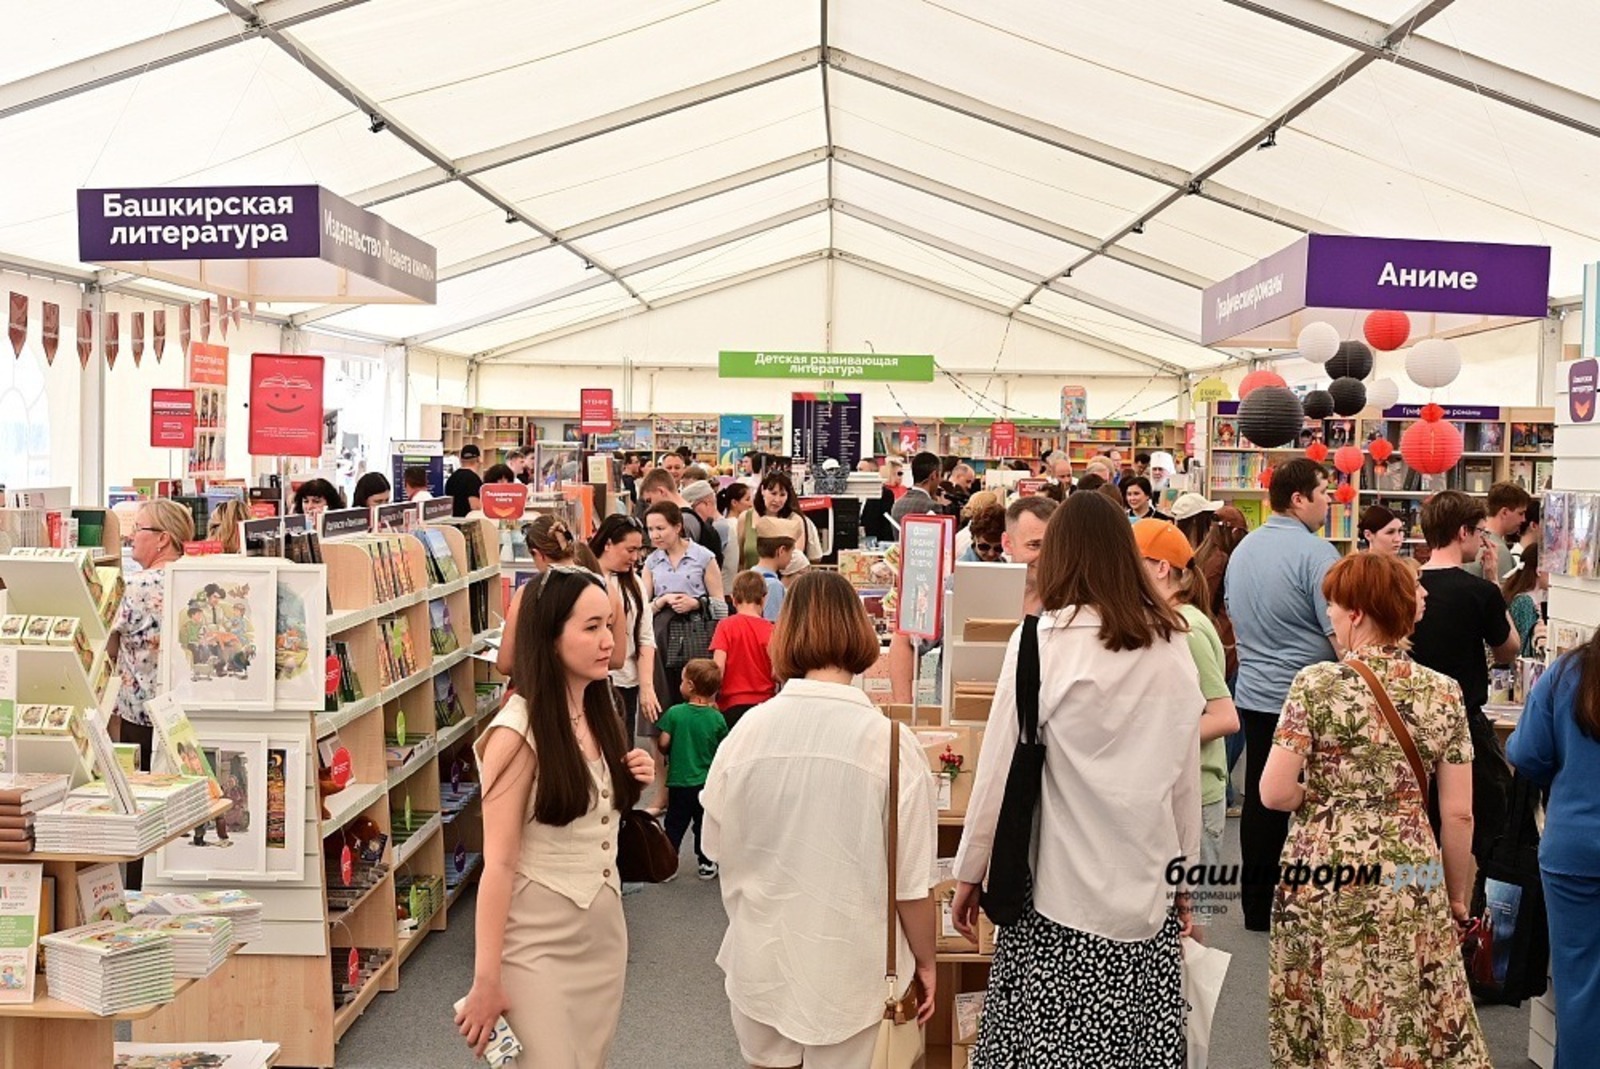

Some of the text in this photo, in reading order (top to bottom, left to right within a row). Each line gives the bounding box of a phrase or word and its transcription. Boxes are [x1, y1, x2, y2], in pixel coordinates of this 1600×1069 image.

[103, 193, 294, 222] Башкирская
[109, 222, 289, 251] литература
[1377, 261, 1479, 291] Аниме
[754, 353, 898, 367] Детская развивающая
[788, 364, 864, 376] литература
